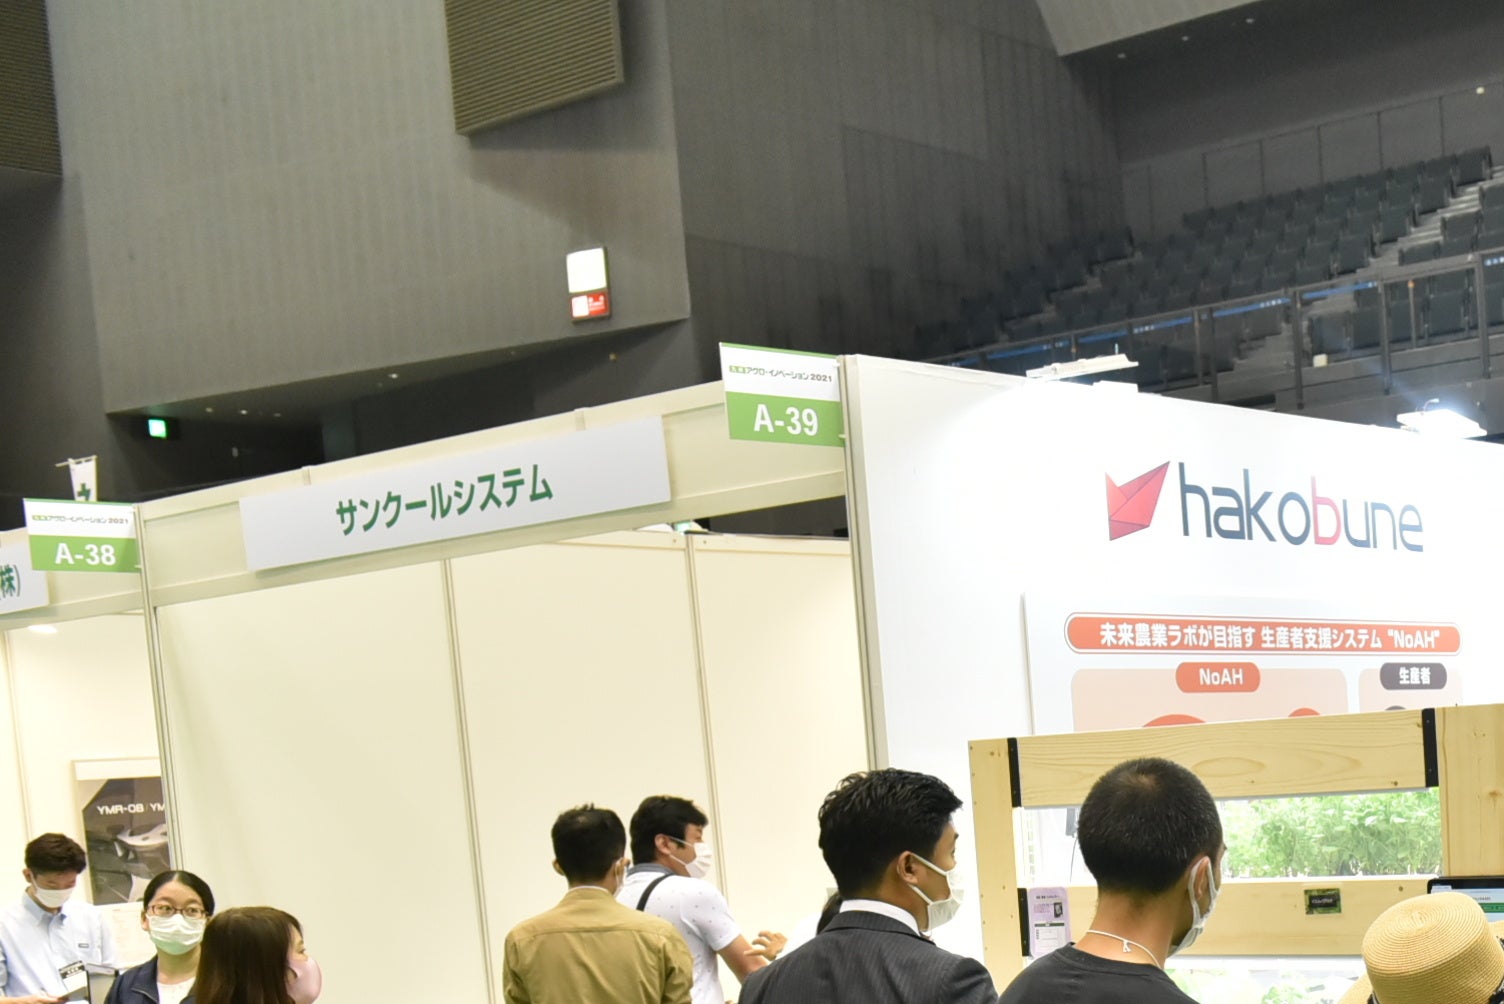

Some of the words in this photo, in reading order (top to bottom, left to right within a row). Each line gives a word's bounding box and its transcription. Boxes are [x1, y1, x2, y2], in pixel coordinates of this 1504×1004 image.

[810, 373, 832, 382] 2021
[753, 403, 818, 436] A-39
[336, 464, 554, 536] サンクールシステム
[1178, 461, 1424, 552] hakobune
[55, 543, 116, 565] A-38
[1100, 622, 1256, 648] 未来農業ラボが目指す
[1261, 626, 1382, 649] 生産者支援システム
[1199, 668, 1243, 685] NoAH
[1399, 667, 1431, 685] 生産者
